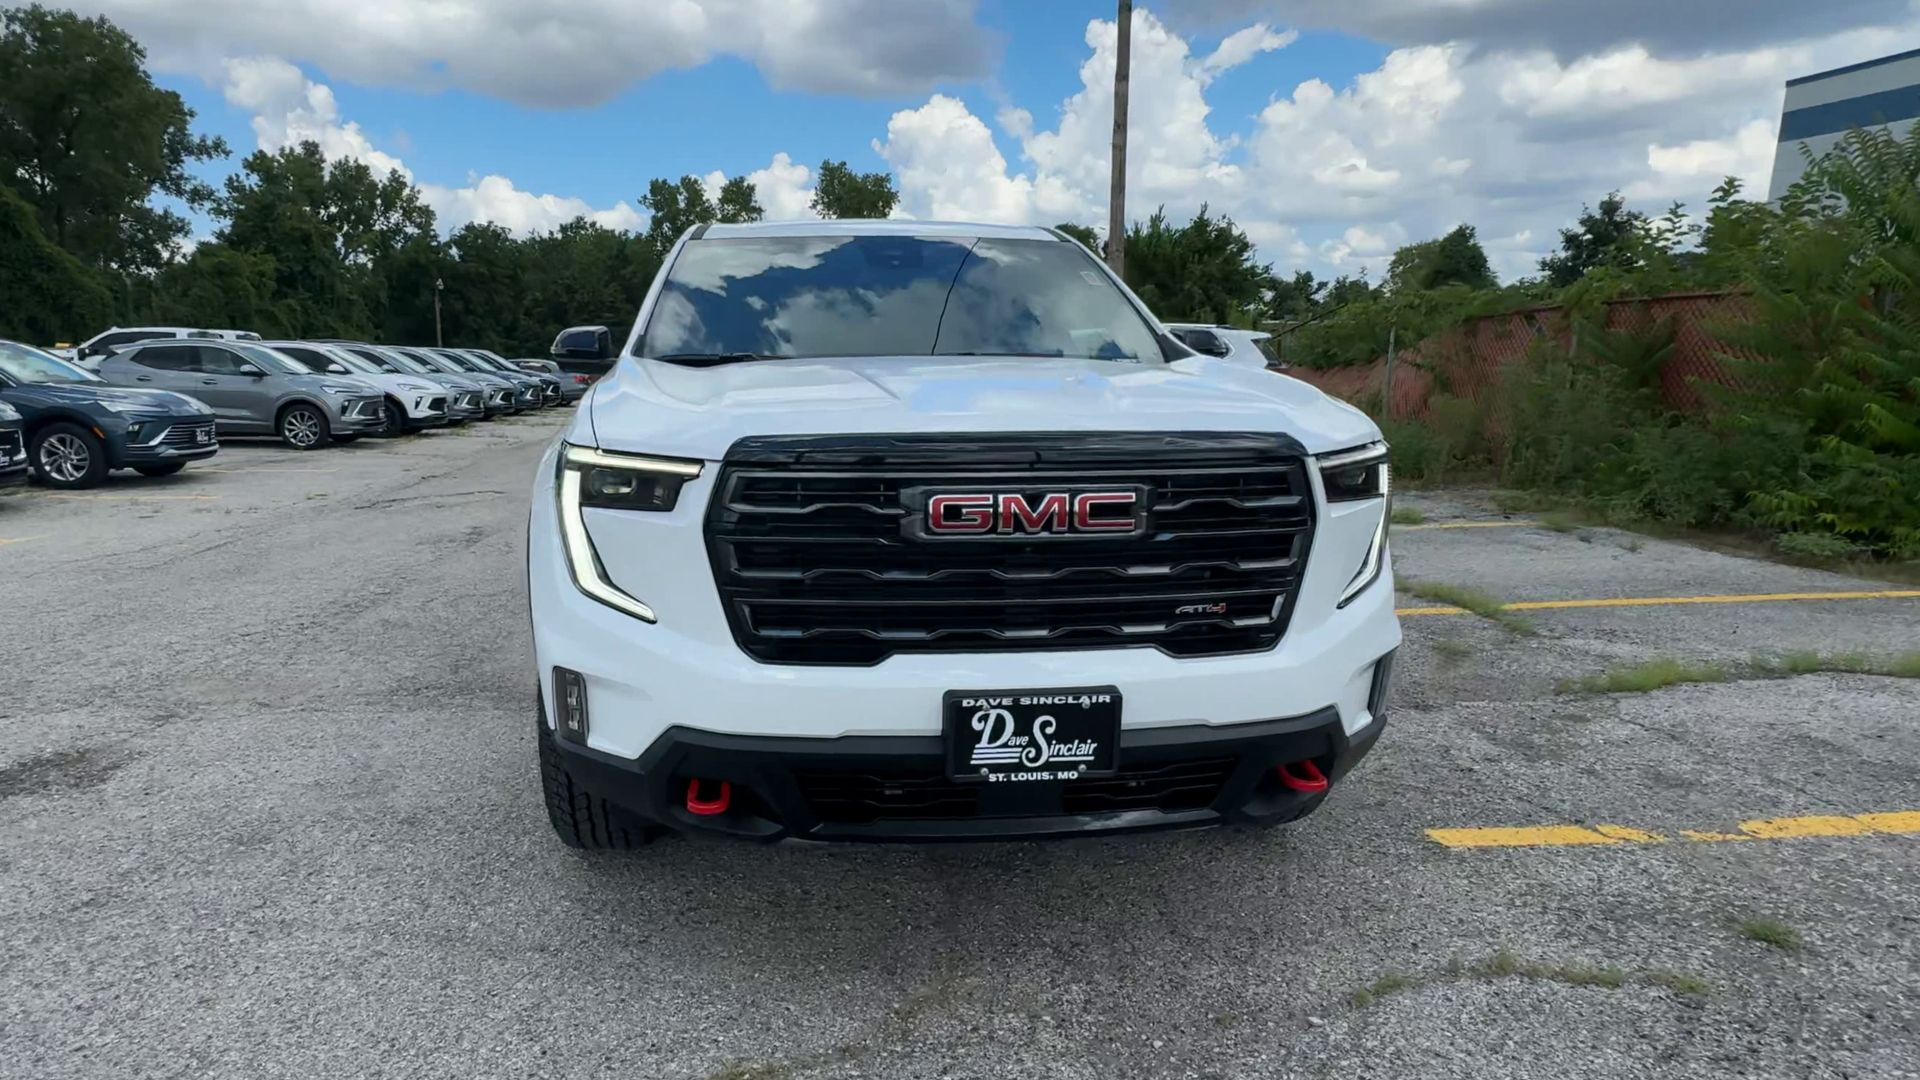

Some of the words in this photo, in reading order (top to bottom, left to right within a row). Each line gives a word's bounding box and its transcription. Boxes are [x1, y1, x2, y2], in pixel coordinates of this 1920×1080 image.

[928, 492, 1136, 533] GMC
[1175, 602, 1227, 614] AT4
[962, 697, 1014, 707] DAVE
[1019, 695, 1111, 705] SINCLAIR
[971, 708, 1029, 748] Dave
[1022, 715, 1098, 767] Sinclair
[988, 773, 1007, 782] ST.
[1057, 771, 1079, 780] MO
